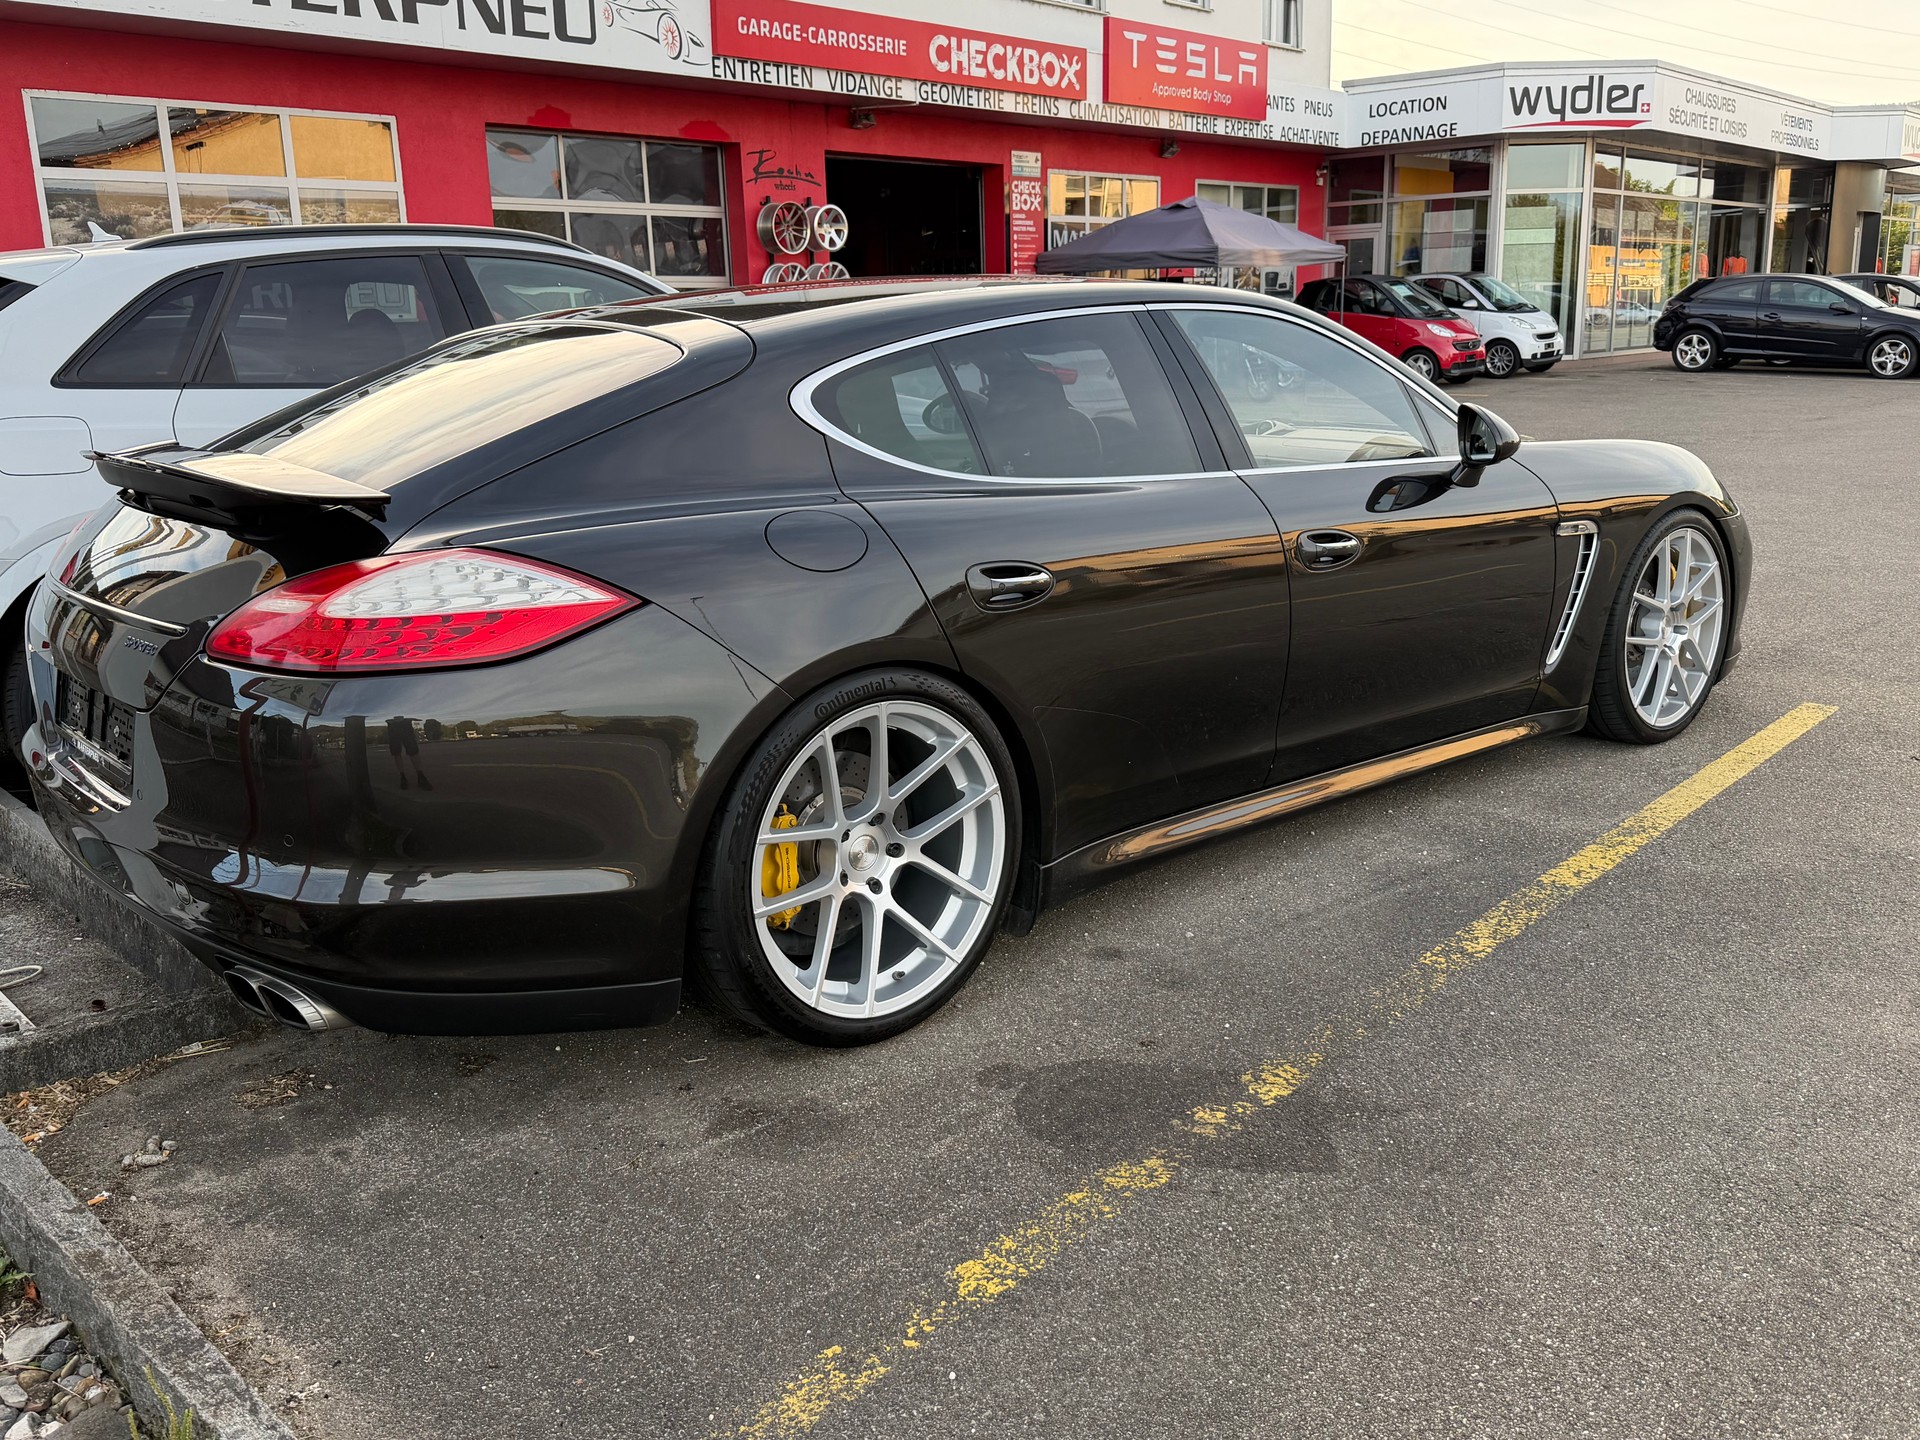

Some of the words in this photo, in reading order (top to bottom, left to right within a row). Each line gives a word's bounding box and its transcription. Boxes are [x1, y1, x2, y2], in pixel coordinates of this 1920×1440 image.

[737, 16, 907, 56] GARAGE-CARROSSERIE
[928, 34, 1082, 91] CHECKBOX
[1122, 30, 1257, 87] TESLA
[712, 56, 813, 89] ENTRETIEN
[827, 70, 903, 99] VIDANGE
[918, 81, 1004, 110] GEOMETRIE
[1014, 93, 1060, 116] FREINS
[1069, 100, 1160, 127] CLIMATISATION
[1169, 112, 1218, 134] BATTERIE
[1225, 119, 1274, 139] EXPERTISE
[1280, 125, 1340, 146] ACHAT-VENTE
[1152, 82, 1191, 98] Approved
[1193, 87, 1212, 103] Body
[1213, 90, 1232, 106] Shop
[1509, 75, 1645, 122] wydler
[1685, 87, 1737, 114] CHAUSSURES
[1304, 99, 1333, 118] PNEUS
[1368, 95, 1448, 119] LOCATION
[1360, 122, 1458, 146] DEPANNAGE
[1668, 105, 1708, 130] SÉCURITÉ
[1709, 116, 1719, 132] ET
[1720, 119, 1748, 139] LOISIRS
[1780, 111, 1813, 132] VÊTEMENTS
[1770, 129, 1820, 151] PROFESSIONNELS
[1011, 180, 1041, 195] CHECK
[1011, 193, 1042, 212] BOX
[814, 677, 887, 720] Continental
